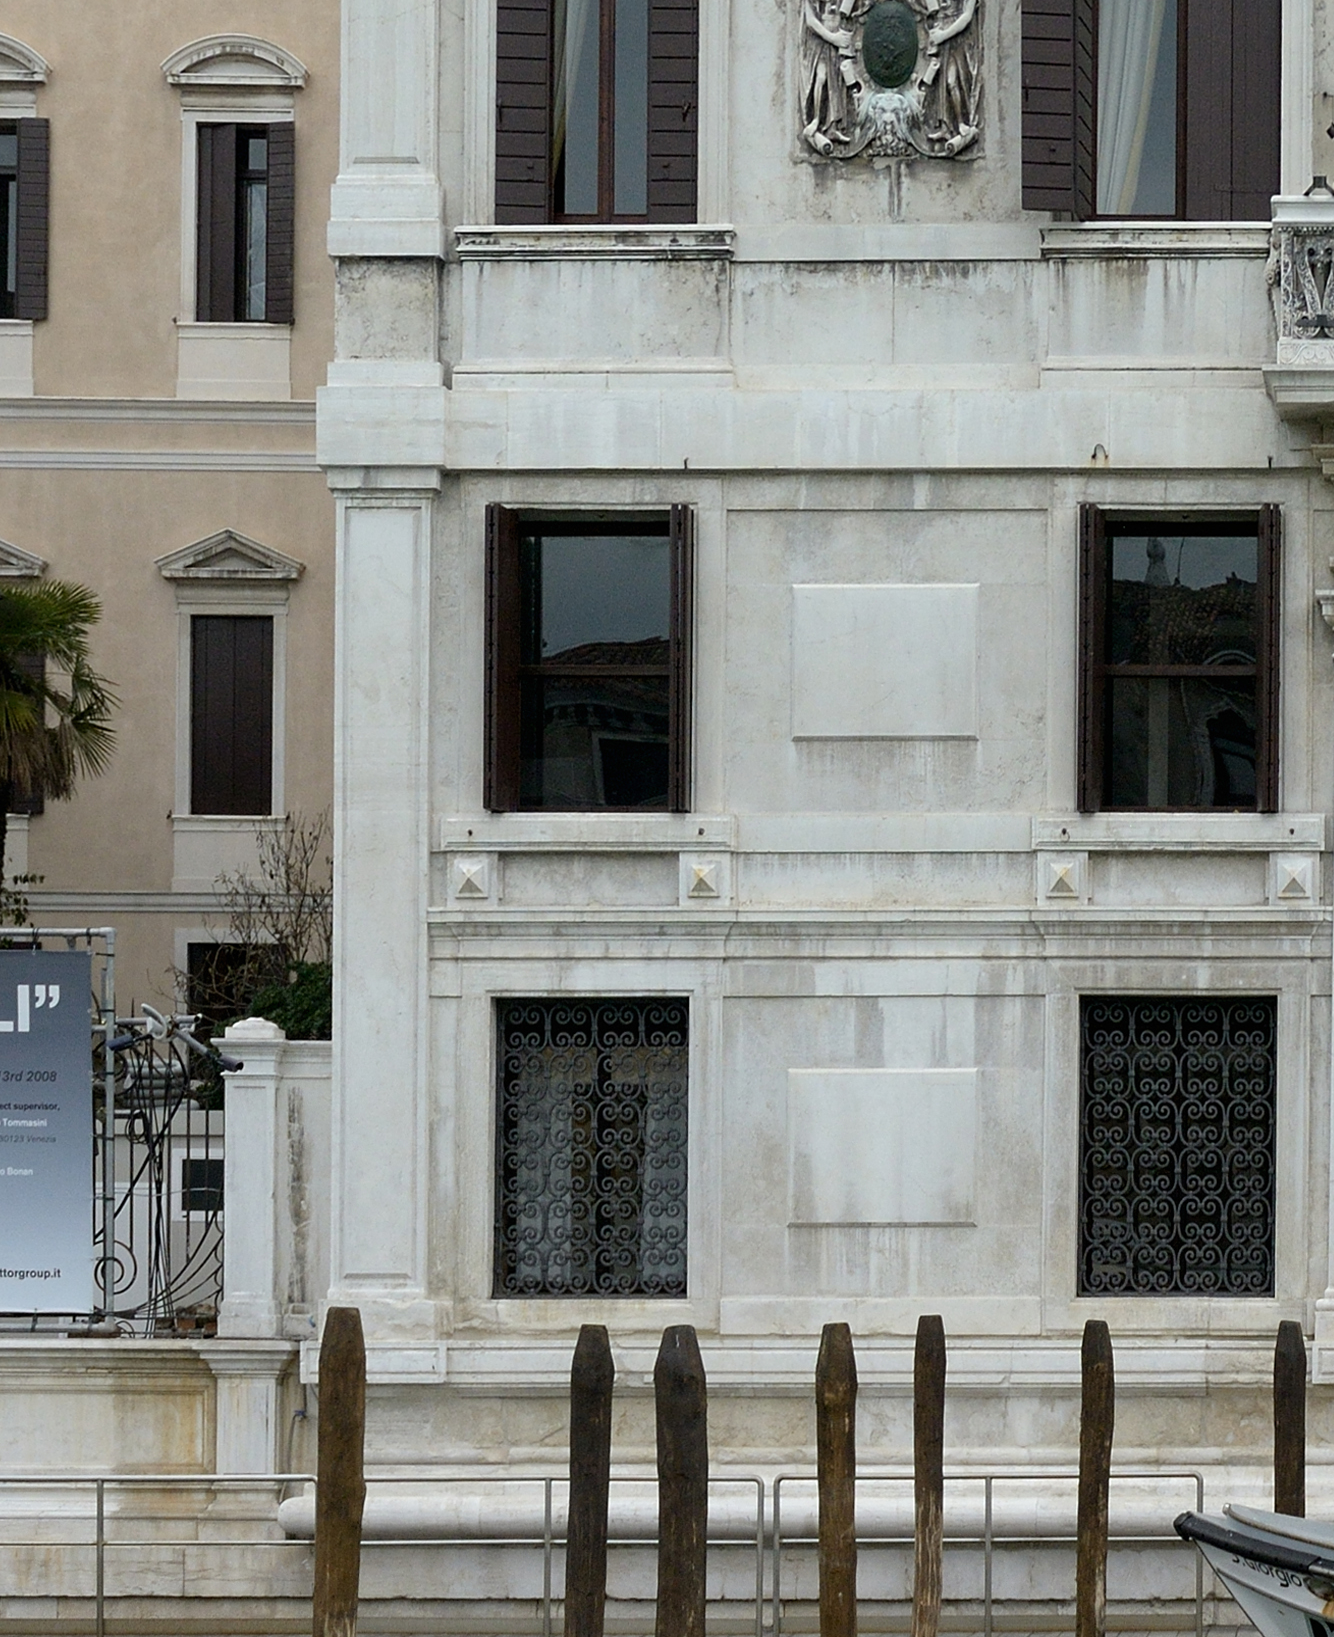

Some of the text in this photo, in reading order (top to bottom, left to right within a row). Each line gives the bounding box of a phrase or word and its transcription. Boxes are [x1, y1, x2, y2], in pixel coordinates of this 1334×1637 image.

[0, 1070, 57, 1083] 3rd 2008
[13, 1102, 61, 1112] supervisor,
[2, 1117, 48, 1127] Tommasini
[7, 1166, 34, 1176] Bonan
